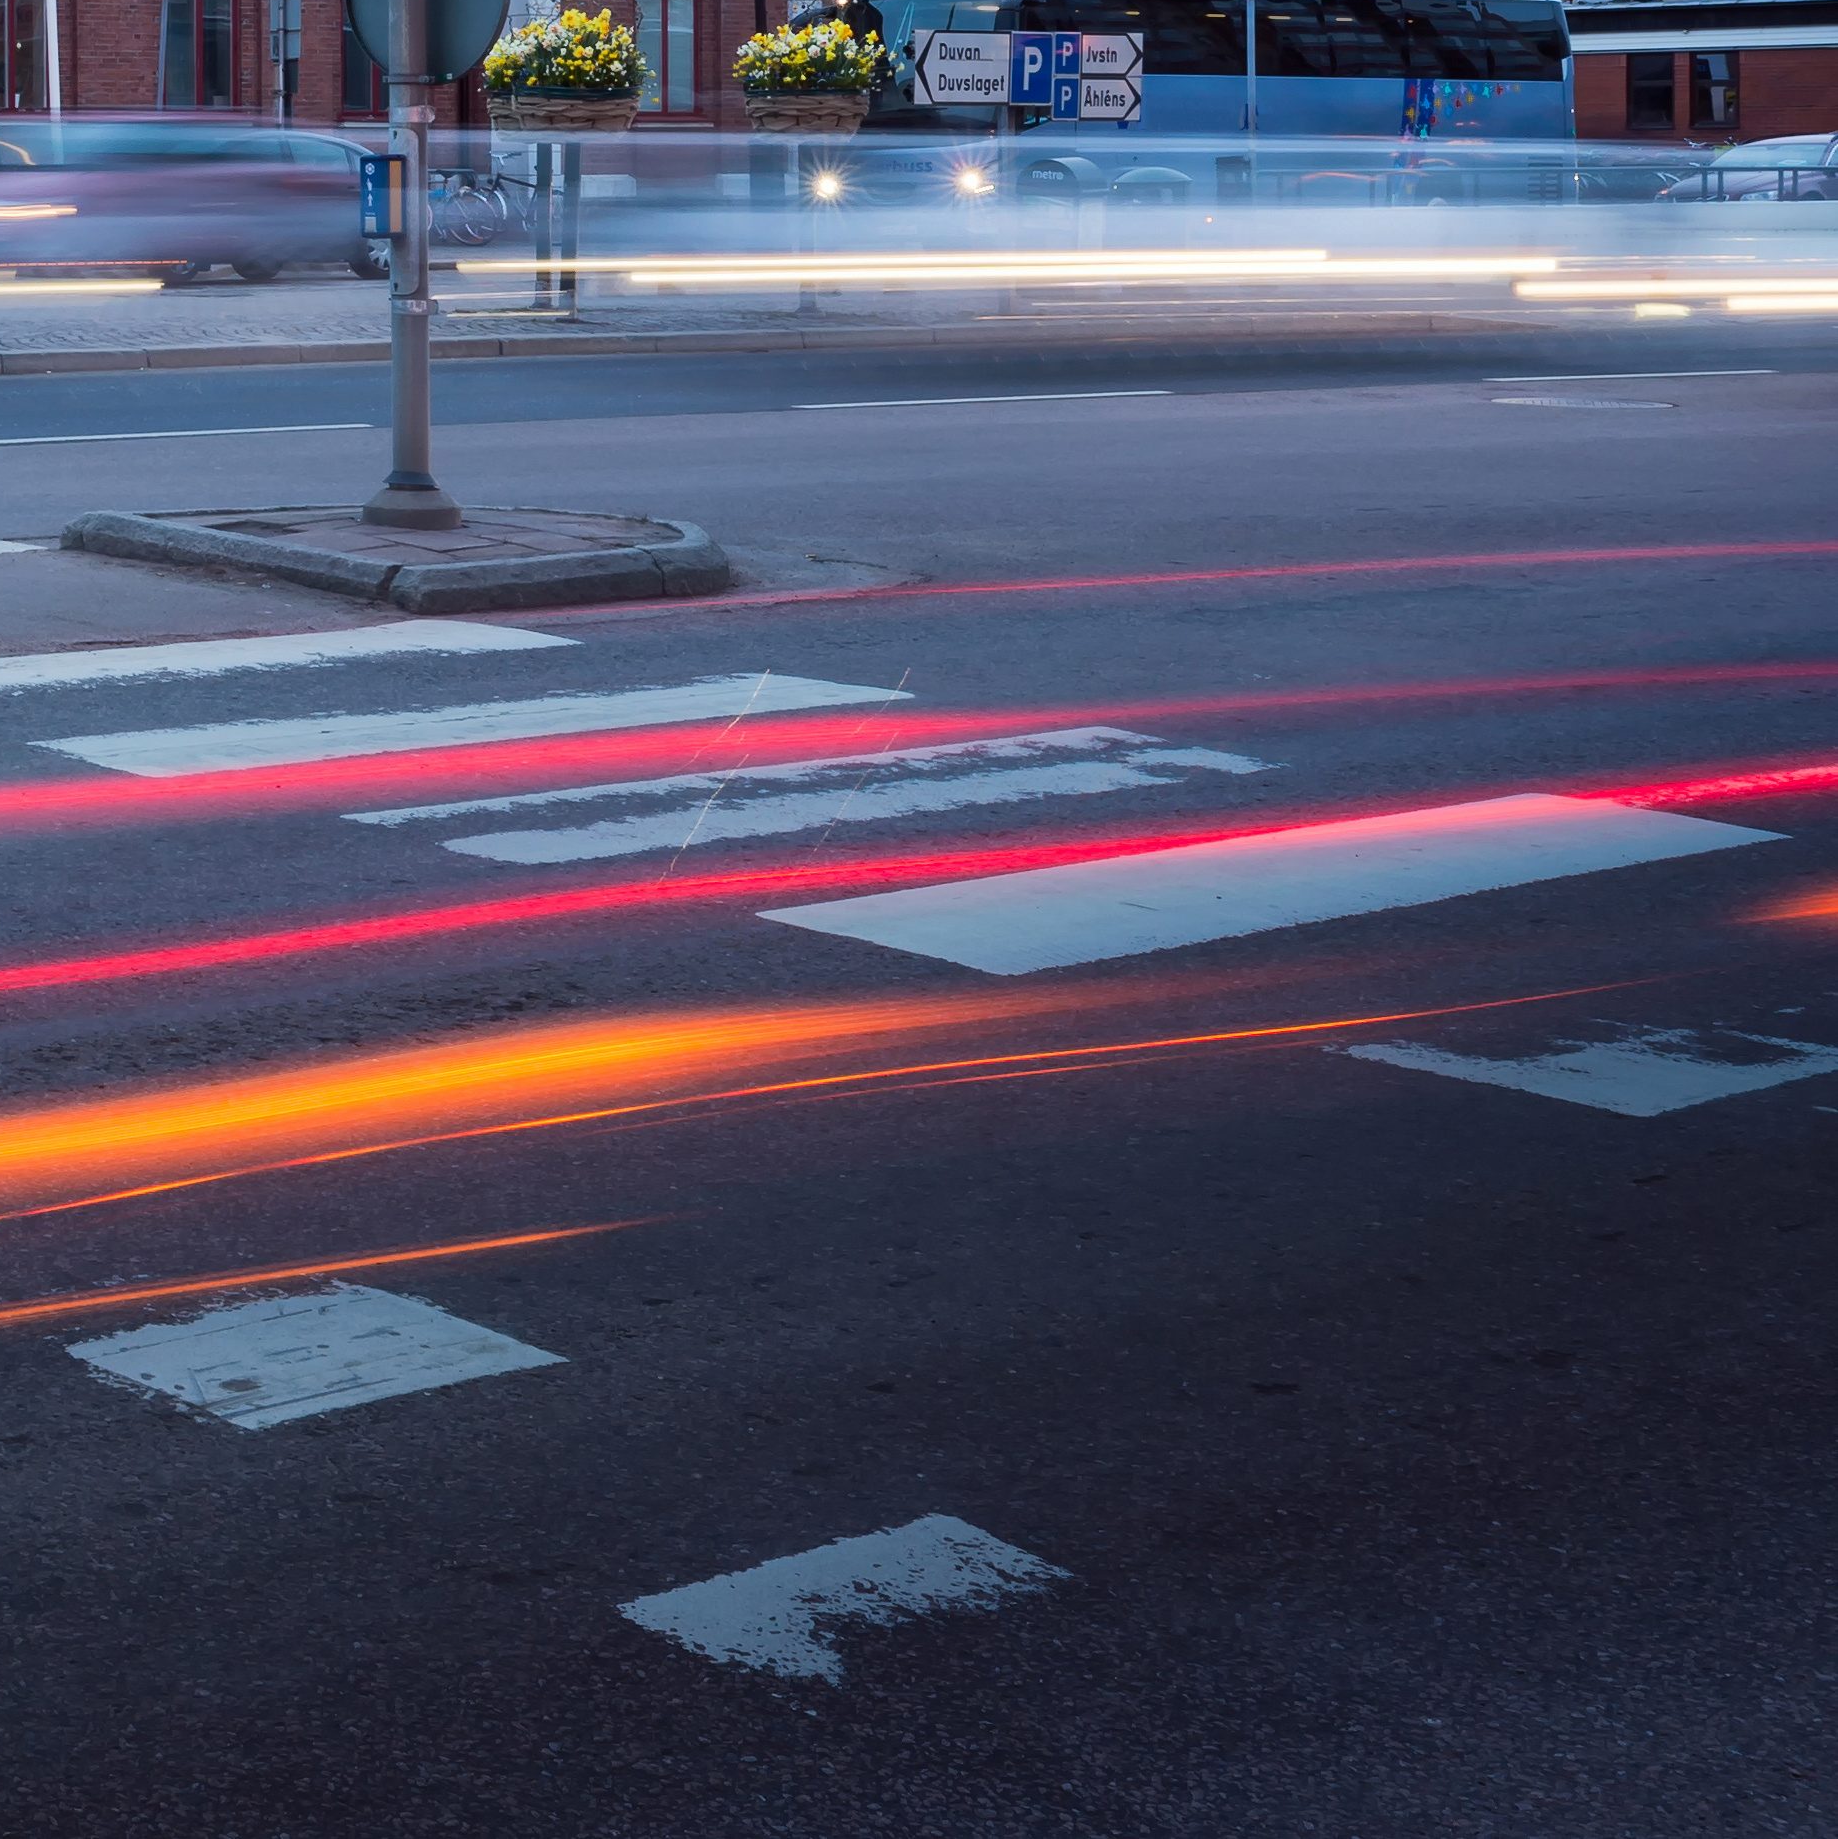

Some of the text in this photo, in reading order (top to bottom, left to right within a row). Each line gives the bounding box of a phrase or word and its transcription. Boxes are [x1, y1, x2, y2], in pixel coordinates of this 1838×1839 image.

[939, 42, 981, 61] Duvan
[1062, 41, 1118, 67] P Jvstn
[1023, 46, 1043, 91] P
[938, 73, 1005, 96] Duvslaget
[1061, 85, 1126, 111] P Åhléns
[1032, 169, 1064, 181] metro
